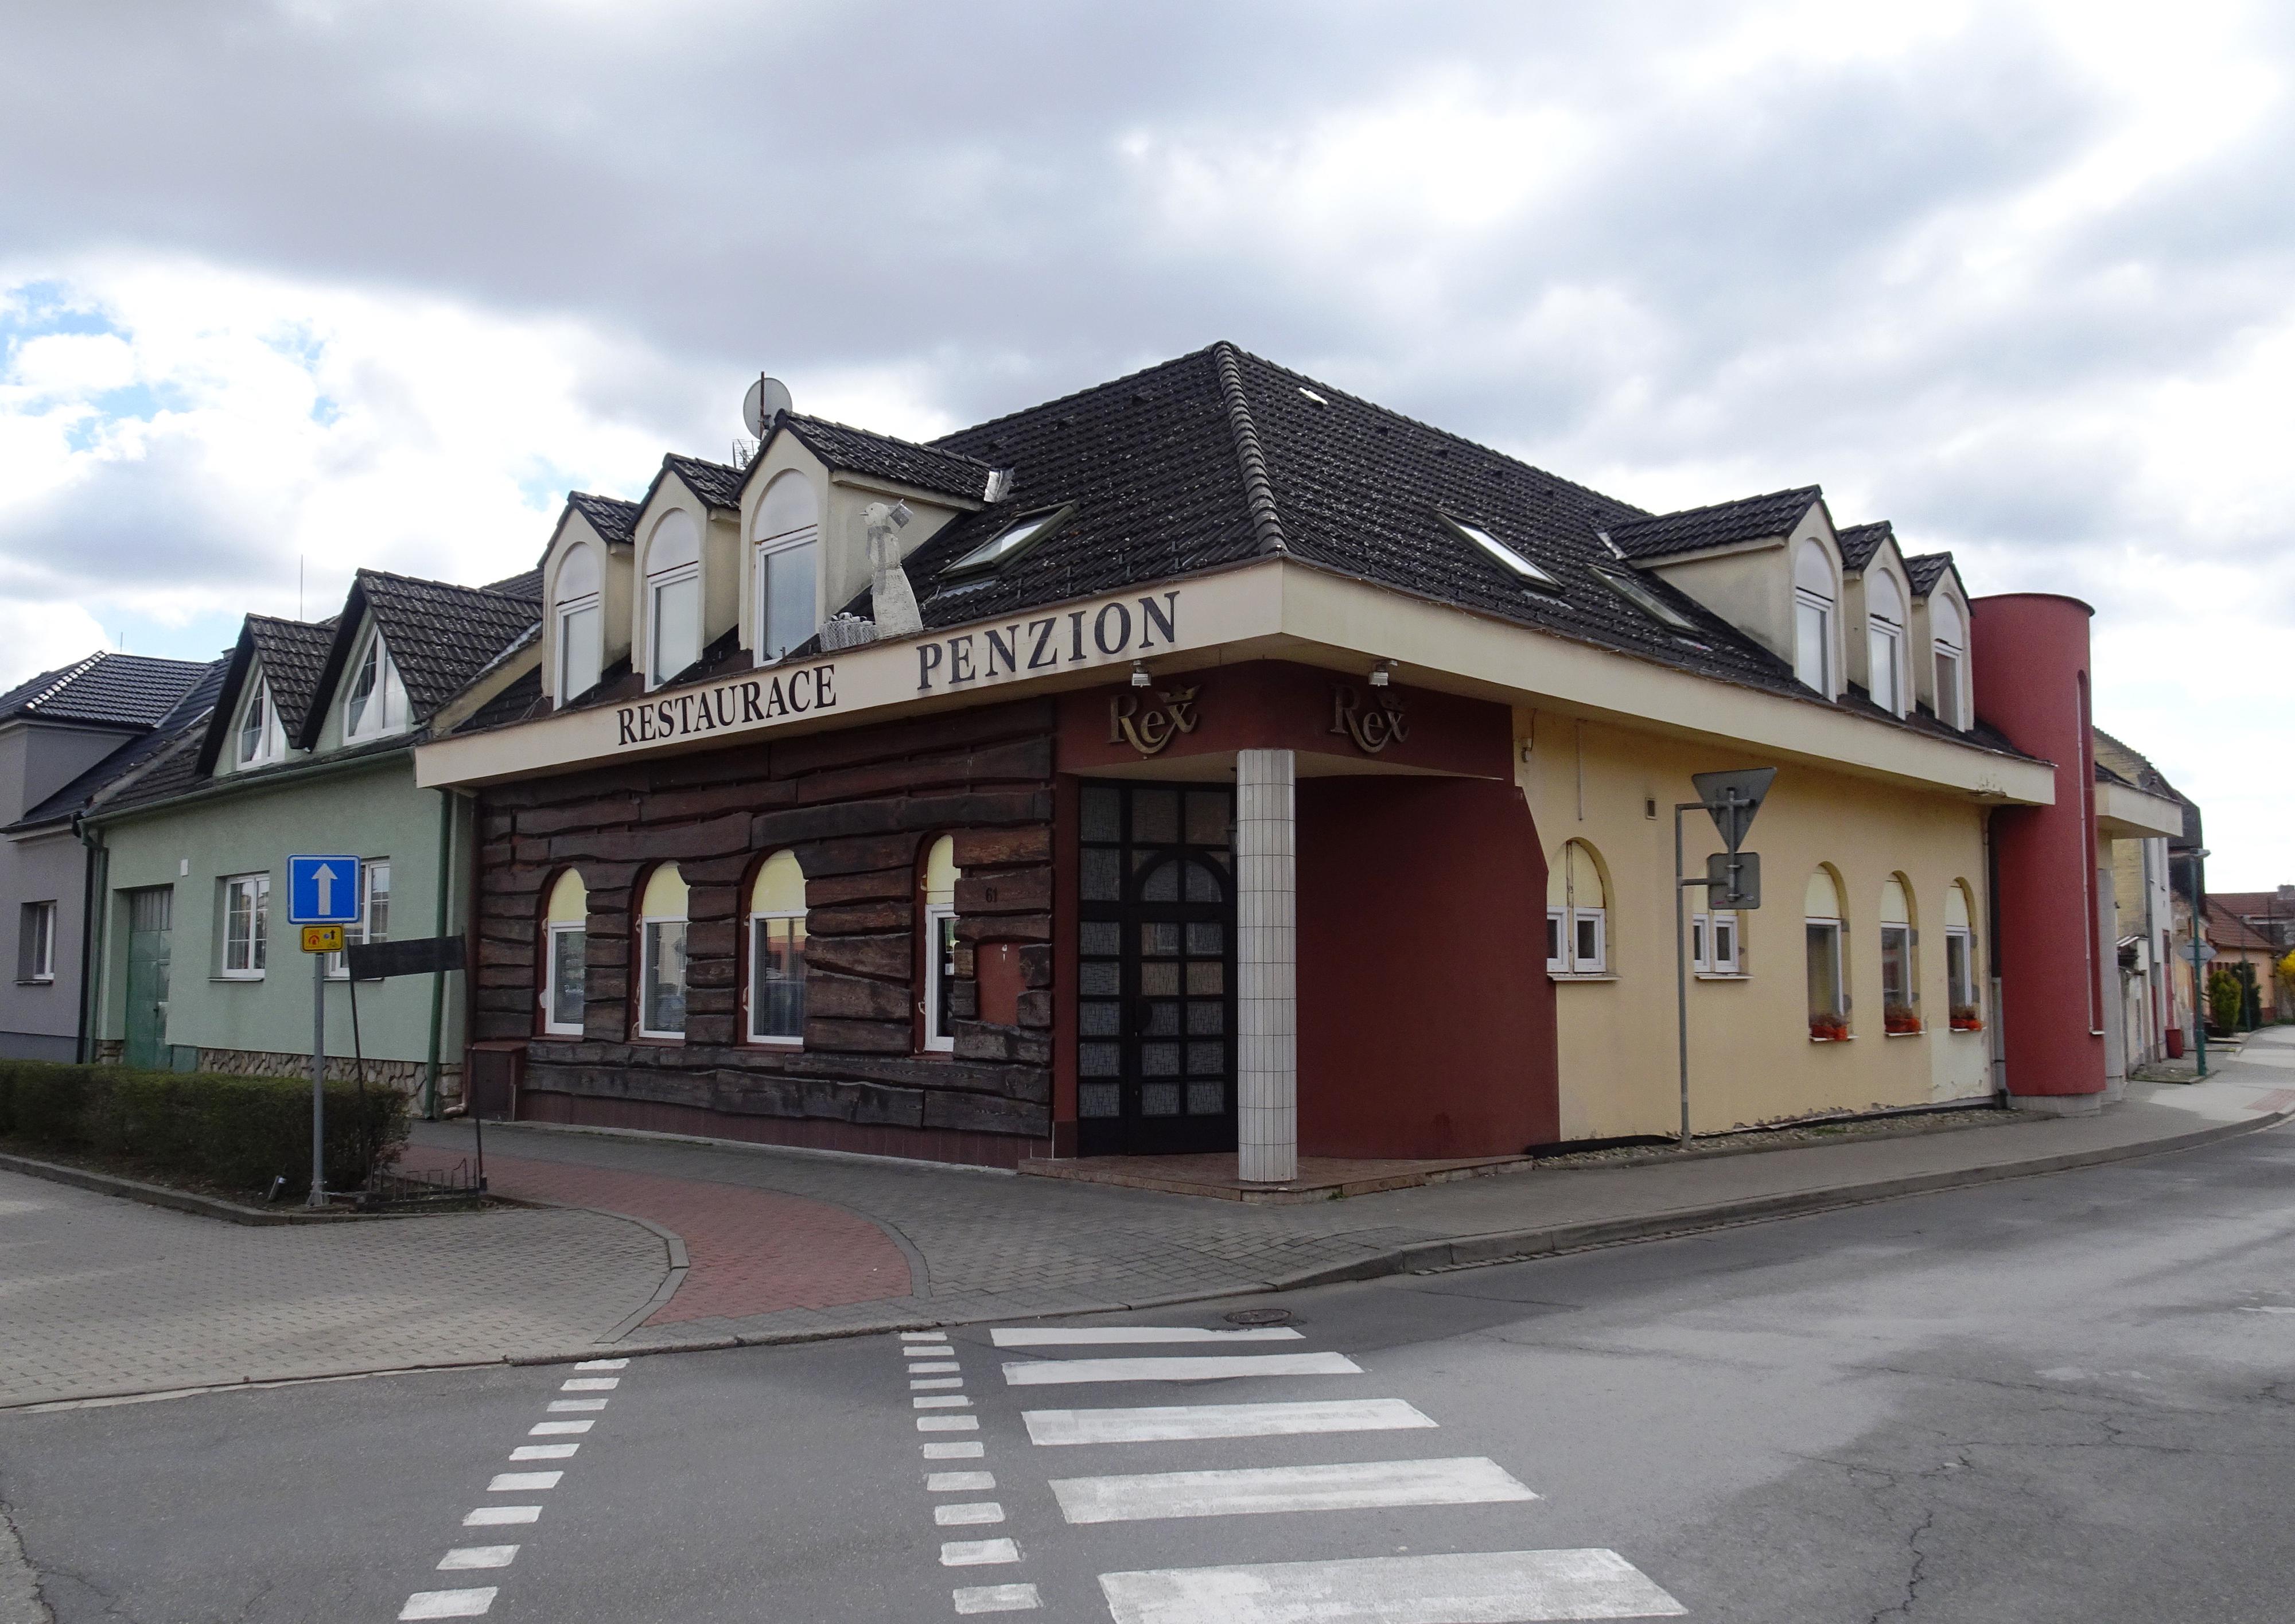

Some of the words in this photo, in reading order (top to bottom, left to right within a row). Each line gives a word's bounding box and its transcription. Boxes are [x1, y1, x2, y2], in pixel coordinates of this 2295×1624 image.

[617, 664, 836, 745] RESTAURACE
[916, 590, 1180, 690] PENZION
[1106, 692, 1197, 754] Rex
[1329, 684, 1409, 753] Rex
[986, 887, 997, 902] 61
